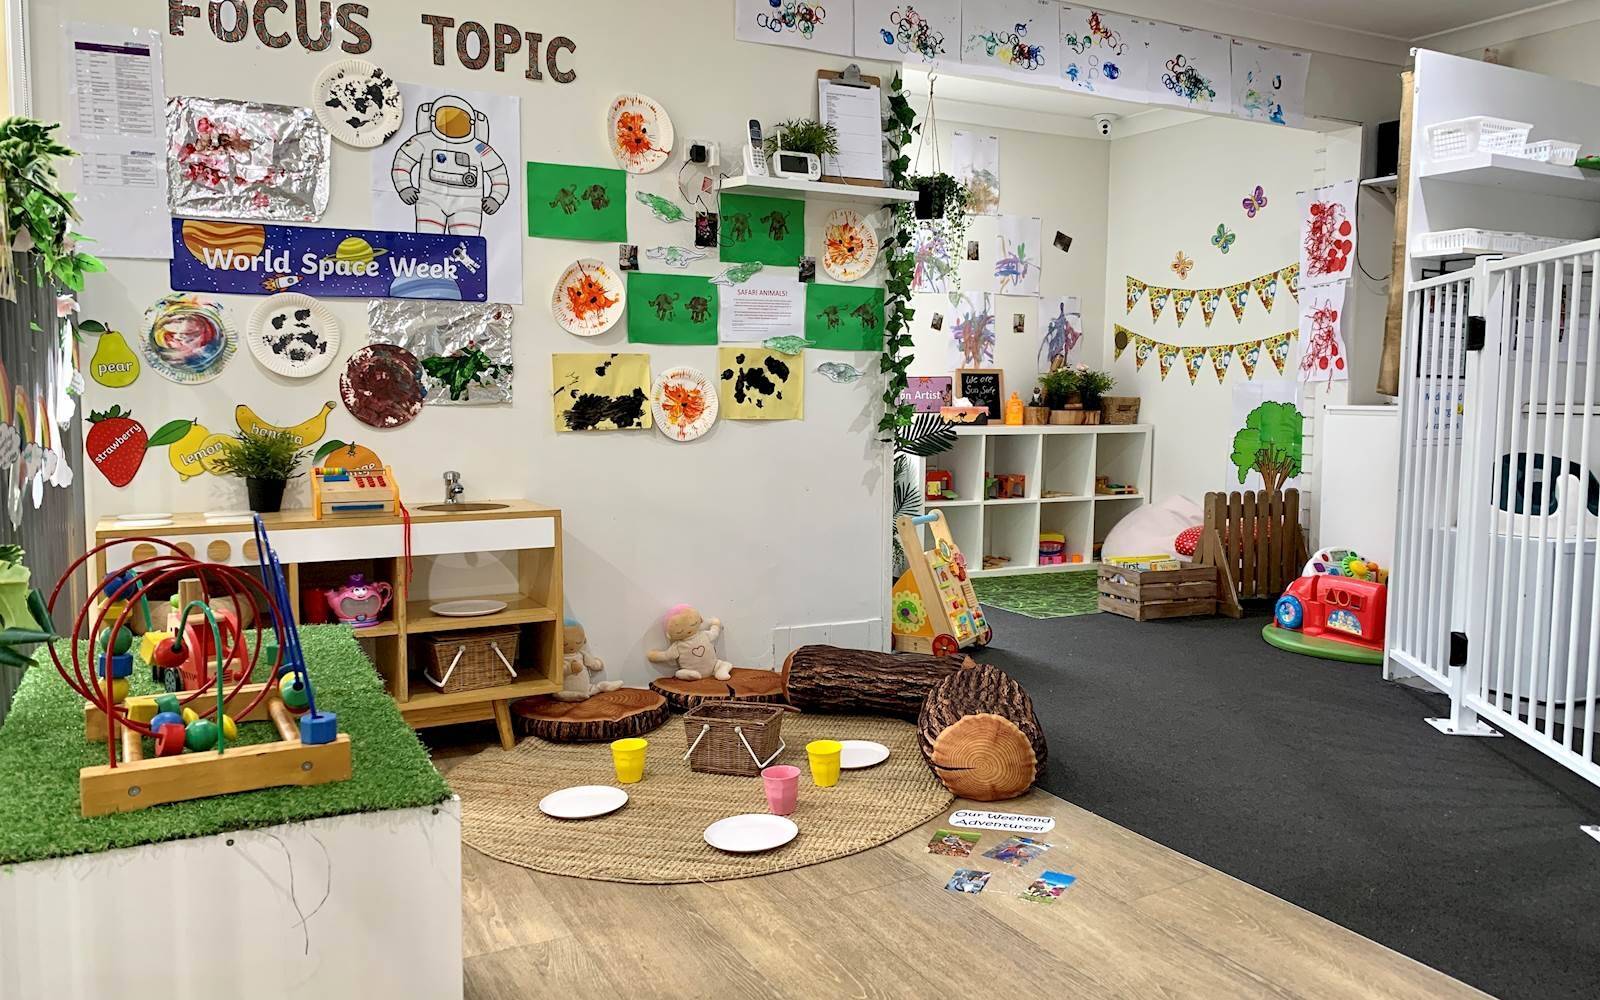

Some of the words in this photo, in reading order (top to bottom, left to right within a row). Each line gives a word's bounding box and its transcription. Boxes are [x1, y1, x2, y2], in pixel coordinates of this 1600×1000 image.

[168, 0, 373, 55] FOCUS
[421, 13, 577, 84] TOPIC
[202, 247, 291, 274] World
[301, 252, 379, 281] Space
[389, 256, 459, 280] Week
[737, 288, 758, 296] SAFARI
[759, 289, 788, 297] ANIMALS!
[1136, 343, 1284, 370] Garden
[98, 361, 133, 377] pear
[965, 375, 979, 385] We
[980, 376, 994, 384] are
[914, 389, 941, 400] Artist
[965, 384, 979, 395] Sun
[980, 385, 996, 395] Safe
[94, 423, 142, 464] strawberry
[179, 441, 223, 466] lemon
[1122, 561, 1140, 570] first
[987, 813, 1051, 824] Weekend
[954, 819, 1044, 832] Adventures!
